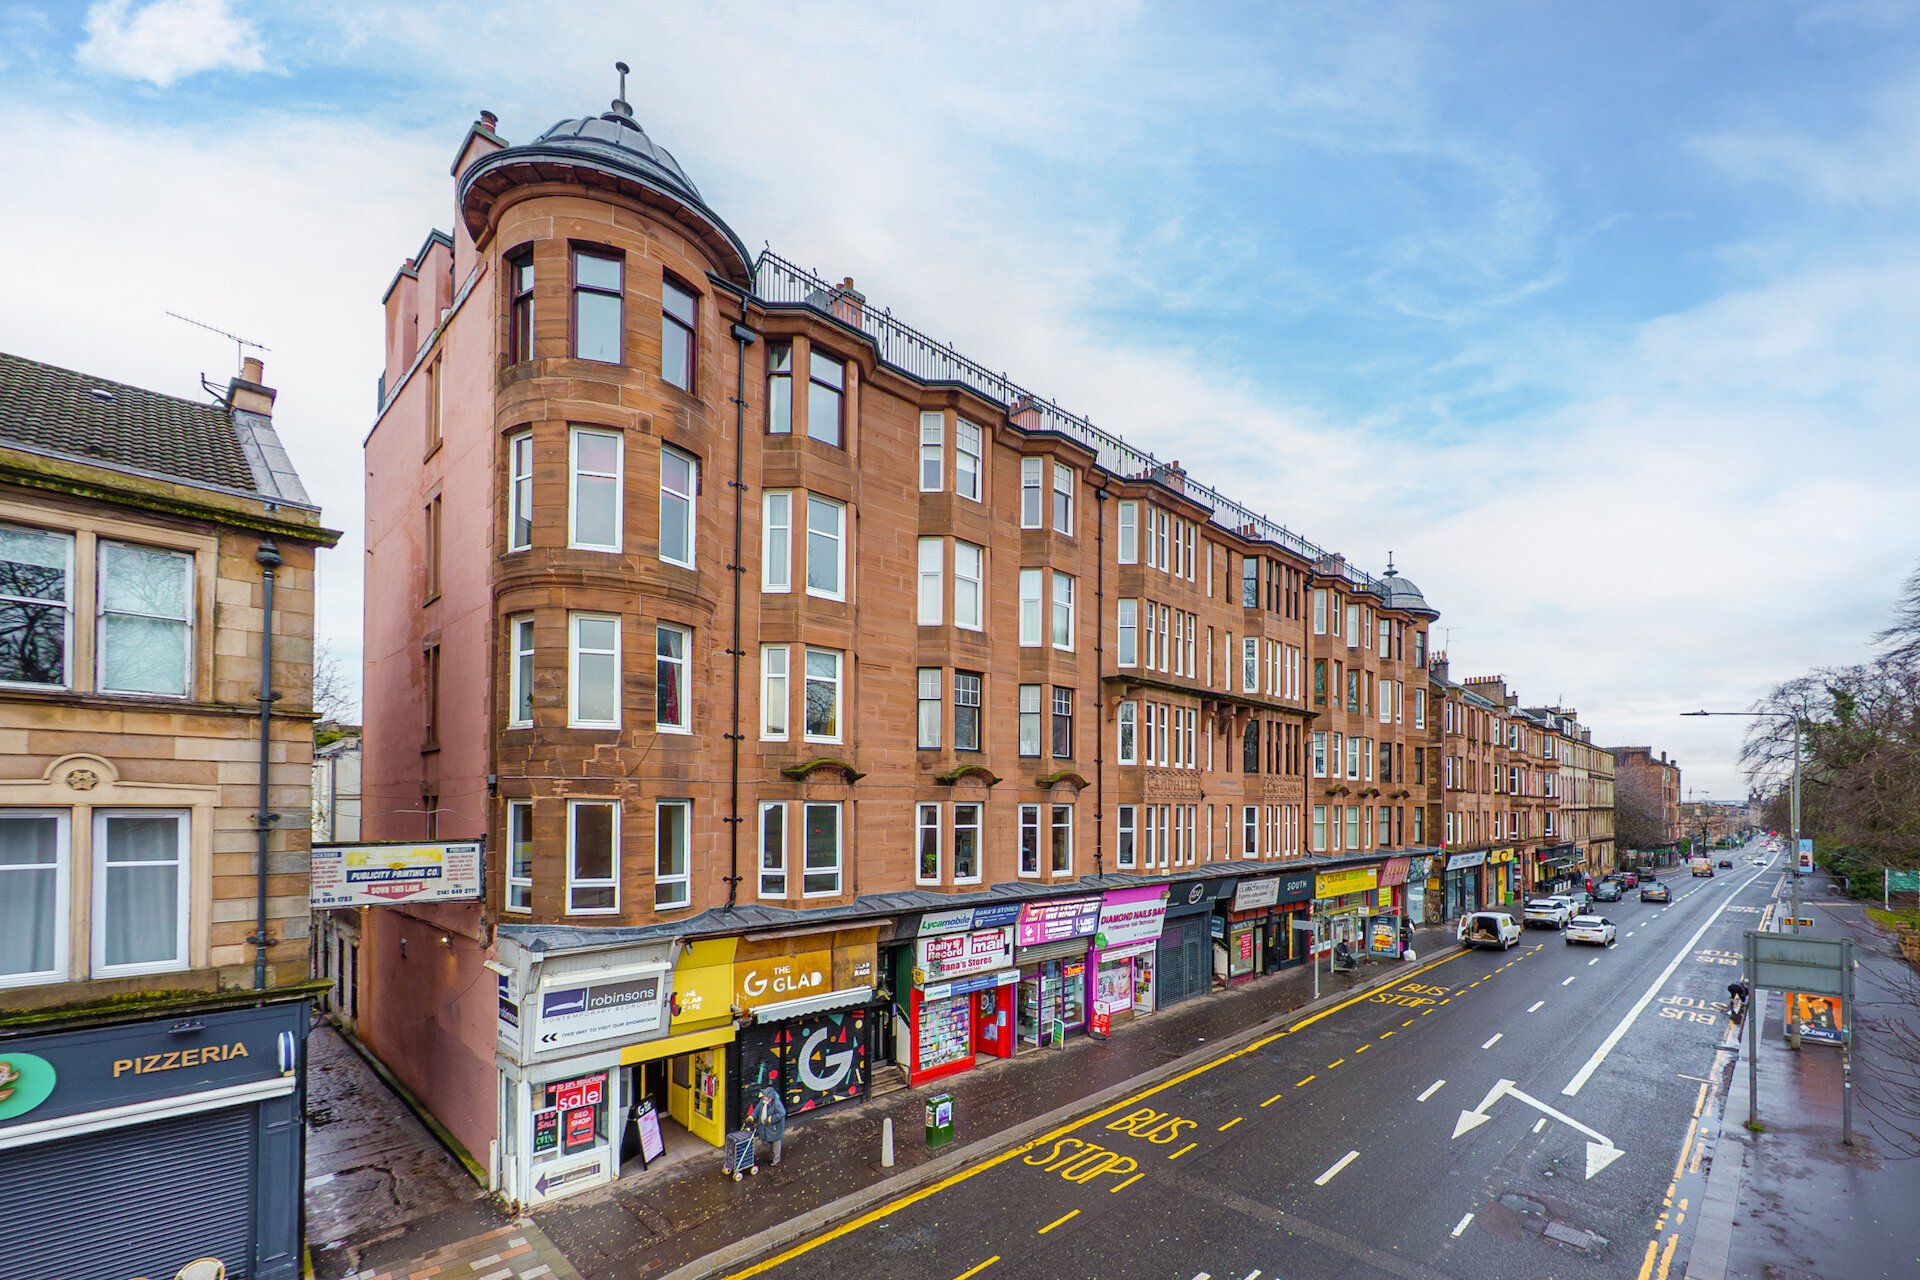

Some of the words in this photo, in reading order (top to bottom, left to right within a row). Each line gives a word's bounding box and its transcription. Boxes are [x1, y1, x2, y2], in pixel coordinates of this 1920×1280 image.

[350, 871, 390, 881] PUBLICITY
[391, 869, 425, 879] PRINTING
[426, 867, 439, 877] CO.
[370, 886, 390, 895] DOWN
[391, 884, 404, 893] THIS
[1286, 880, 1307, 891] SOUTH
[921, 913, 971, 930] Lycamobile
[1101, 911, 1133, 925] DIAMOND
[1133, 908, 1152, 919] NAILS
[1152, 907, 1167, 916] BAR
[928, 940, 952, 952] Daily
[972, 932, 1005, 953] mail
[927, 947, 963, 960] Record
[1695, 956, 1738, 966] BUS
[773, 965, 791, 975] THE
[940, 960, 966, 973] Rana's
[968, 956, 993, 967] Stores
[772, 971, 823, 993] GLAD
[1398, 983, 1451, 996] BUS
[590, 986, 655, 1007] robinsons
[1369, 993, 1437, 1008] STOP
[1658, 995, 1728, 1011] STOP
[542, 1008, 612, 1024] CONTEMPORARY
[615, 1000, 658, 1012] BEDROOMS
[1658, 1007, 1717, 1026] BUS
[576, 1029, 588, 1037] WAY
[625, 1016, 658, 1026] SHOWROOM
[112, 1041, 249, 1078] PIZZERIA
[798, 1026, 854, 1092] G
[559, 1086, 599, 1110] sale
[571, 1116, 592, 1126] SHOP
[573, 1110, 589, 1118] BED
[537, 1119, 557, 1131] SALE
[1105, 1107, 1198, 1144] BUS
[1023, 1137, 1139, 1185] STOP
